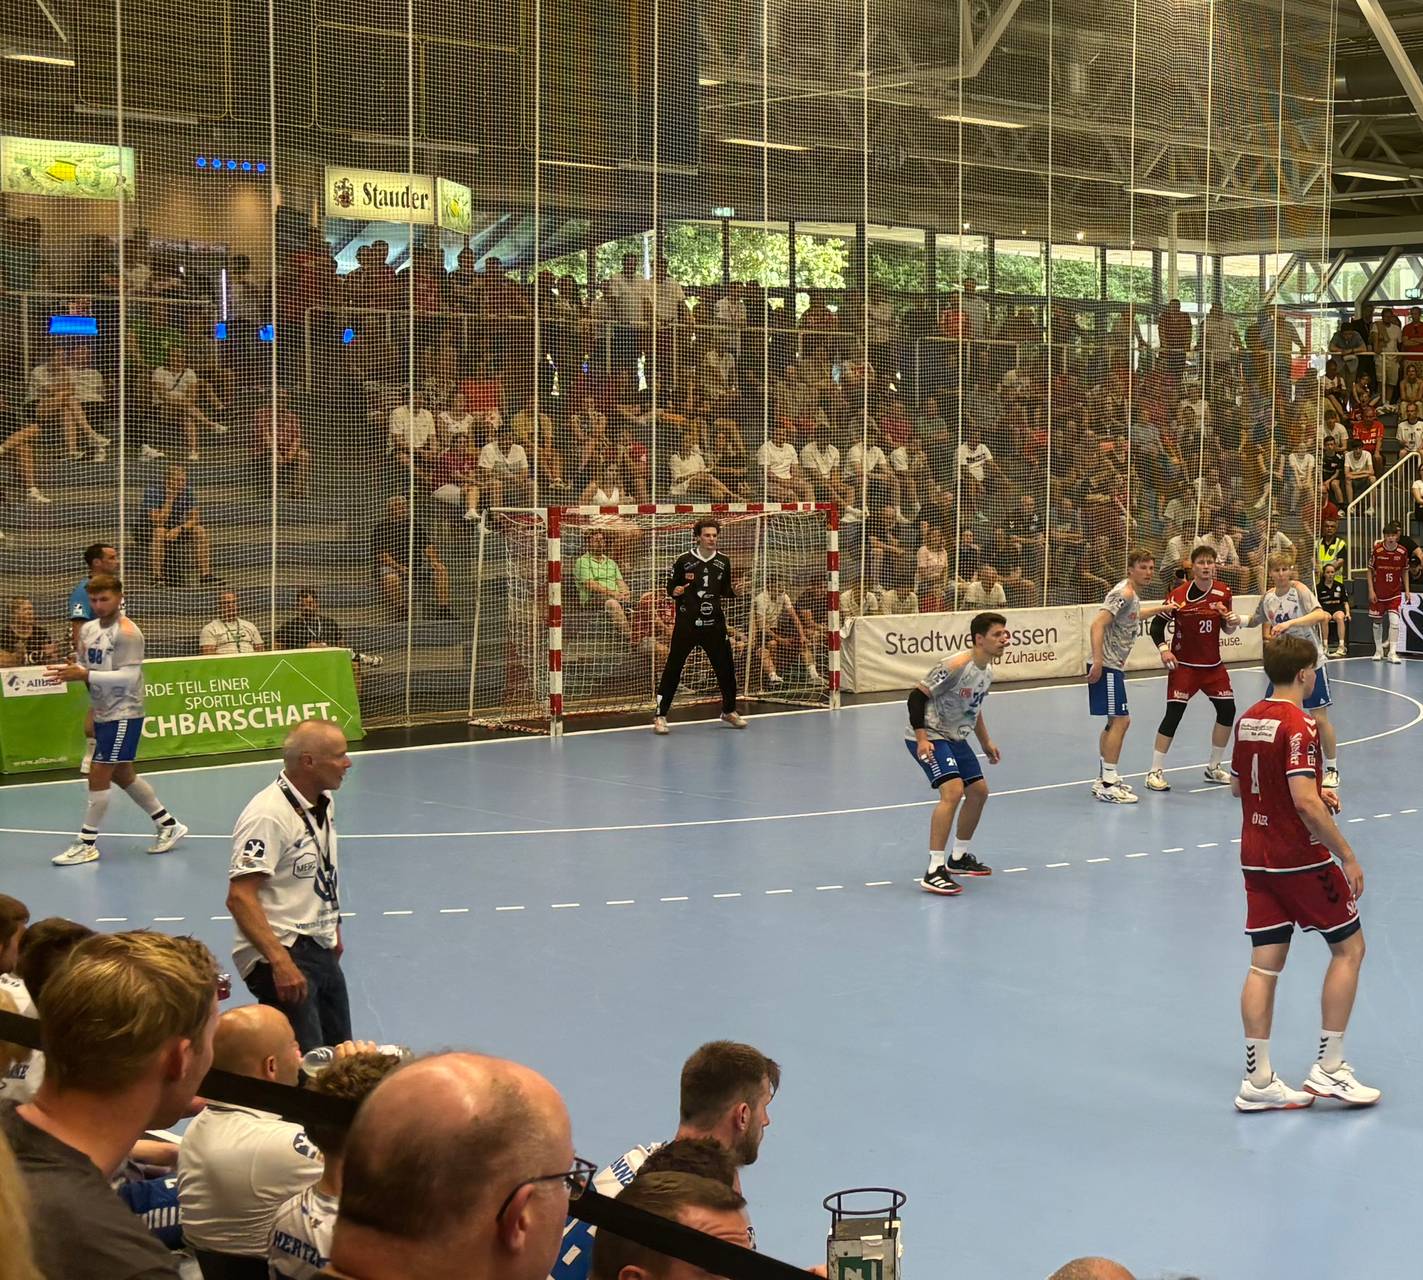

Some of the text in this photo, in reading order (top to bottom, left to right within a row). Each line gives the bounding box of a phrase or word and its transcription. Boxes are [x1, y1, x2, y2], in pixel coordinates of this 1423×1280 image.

[362, 181, 430, 210] Stauder
[702, 575, 709, 587] 1
[1198, 619, 1213, 634] 28
[885, 630, 974, 656] Stadtwe
[1005, 650, 1058, 665] Zuhause.
[144, 677, 250, 698] RDE TEIL EINER
[184, 690, 282, 711] SPORTLICHEN
[142, 702, 338, 739] CHBARSCHAFT.
